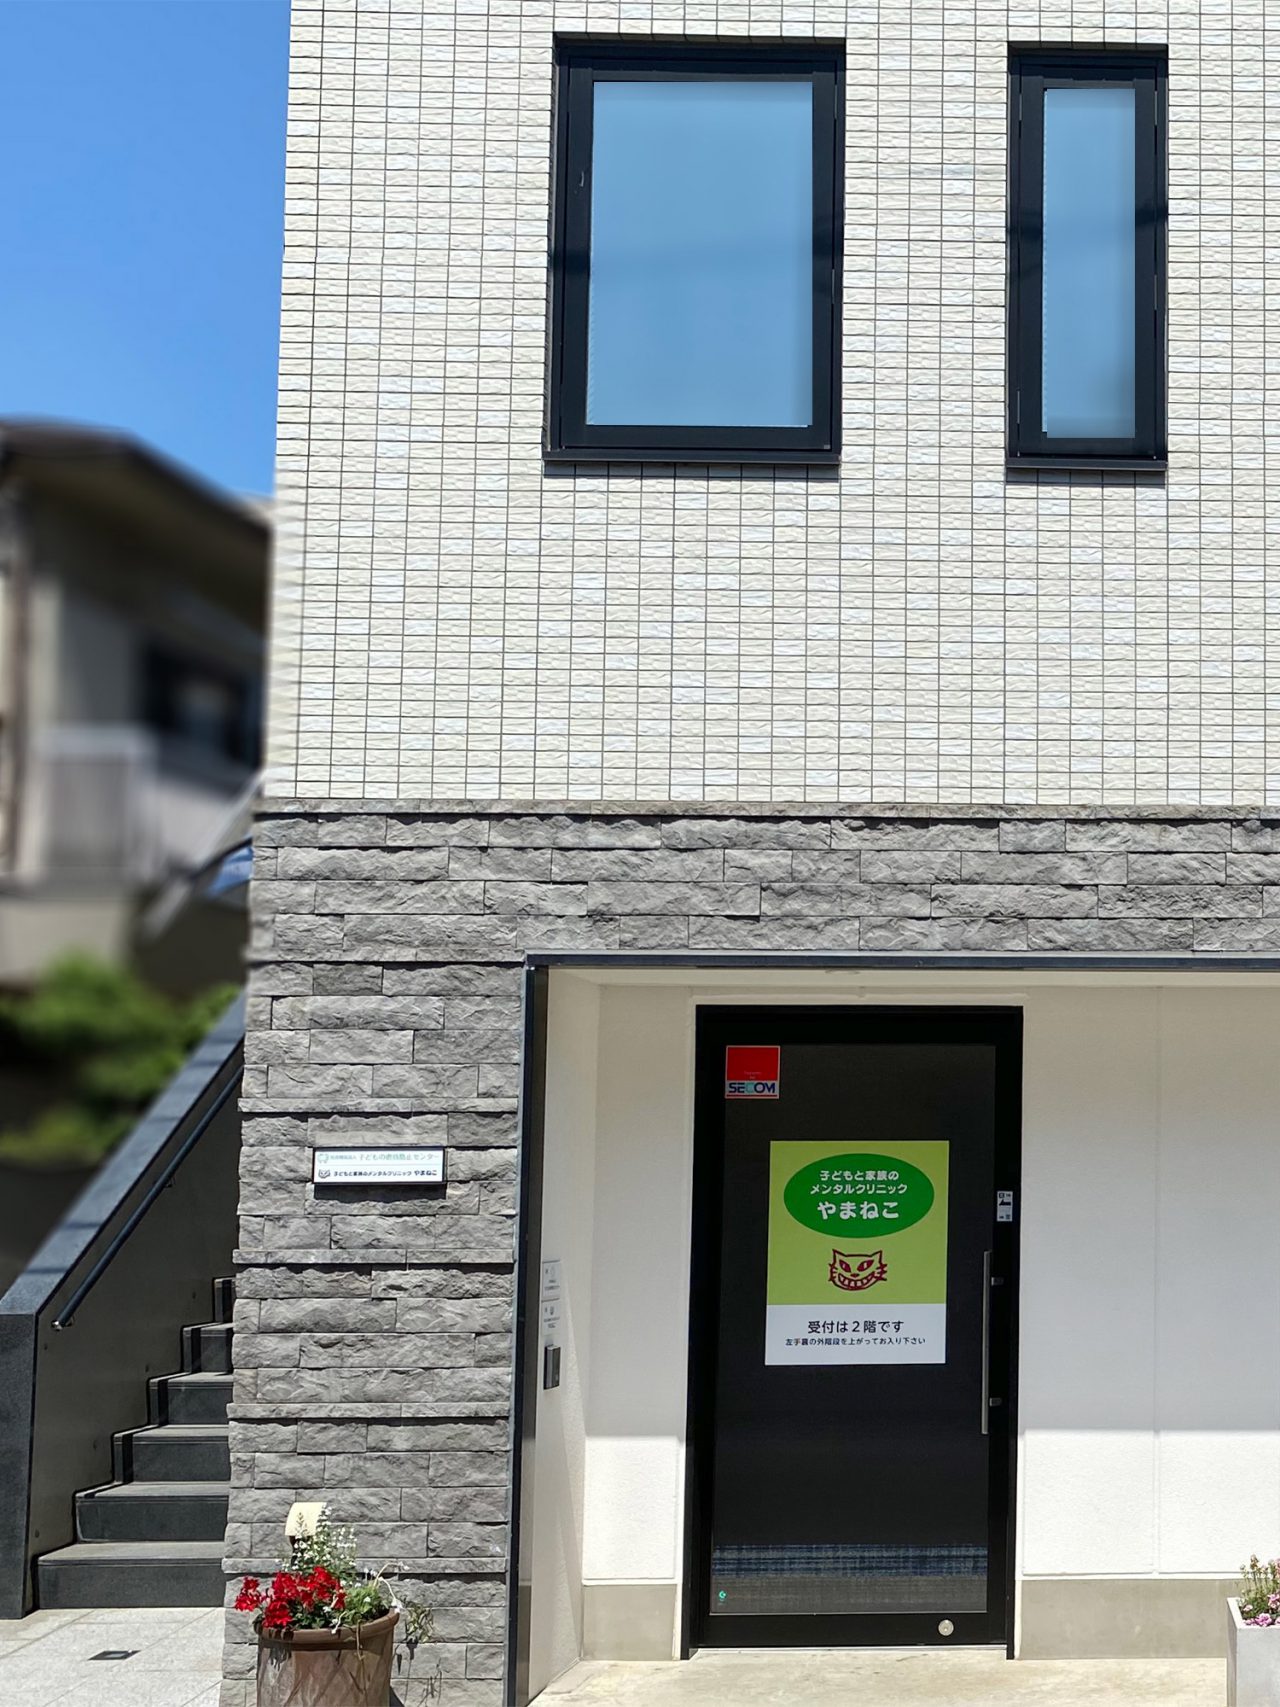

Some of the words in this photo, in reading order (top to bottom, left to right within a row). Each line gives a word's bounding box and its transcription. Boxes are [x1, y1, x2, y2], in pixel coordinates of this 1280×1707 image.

[728, 1082, 776, 1094] SECOM
[819, 1170, 900, 1181] 子どもと家族の
[810, 1184, 908, 1195] メンタルクリニック
[817, 1201, 899, 1220] やまねこ
